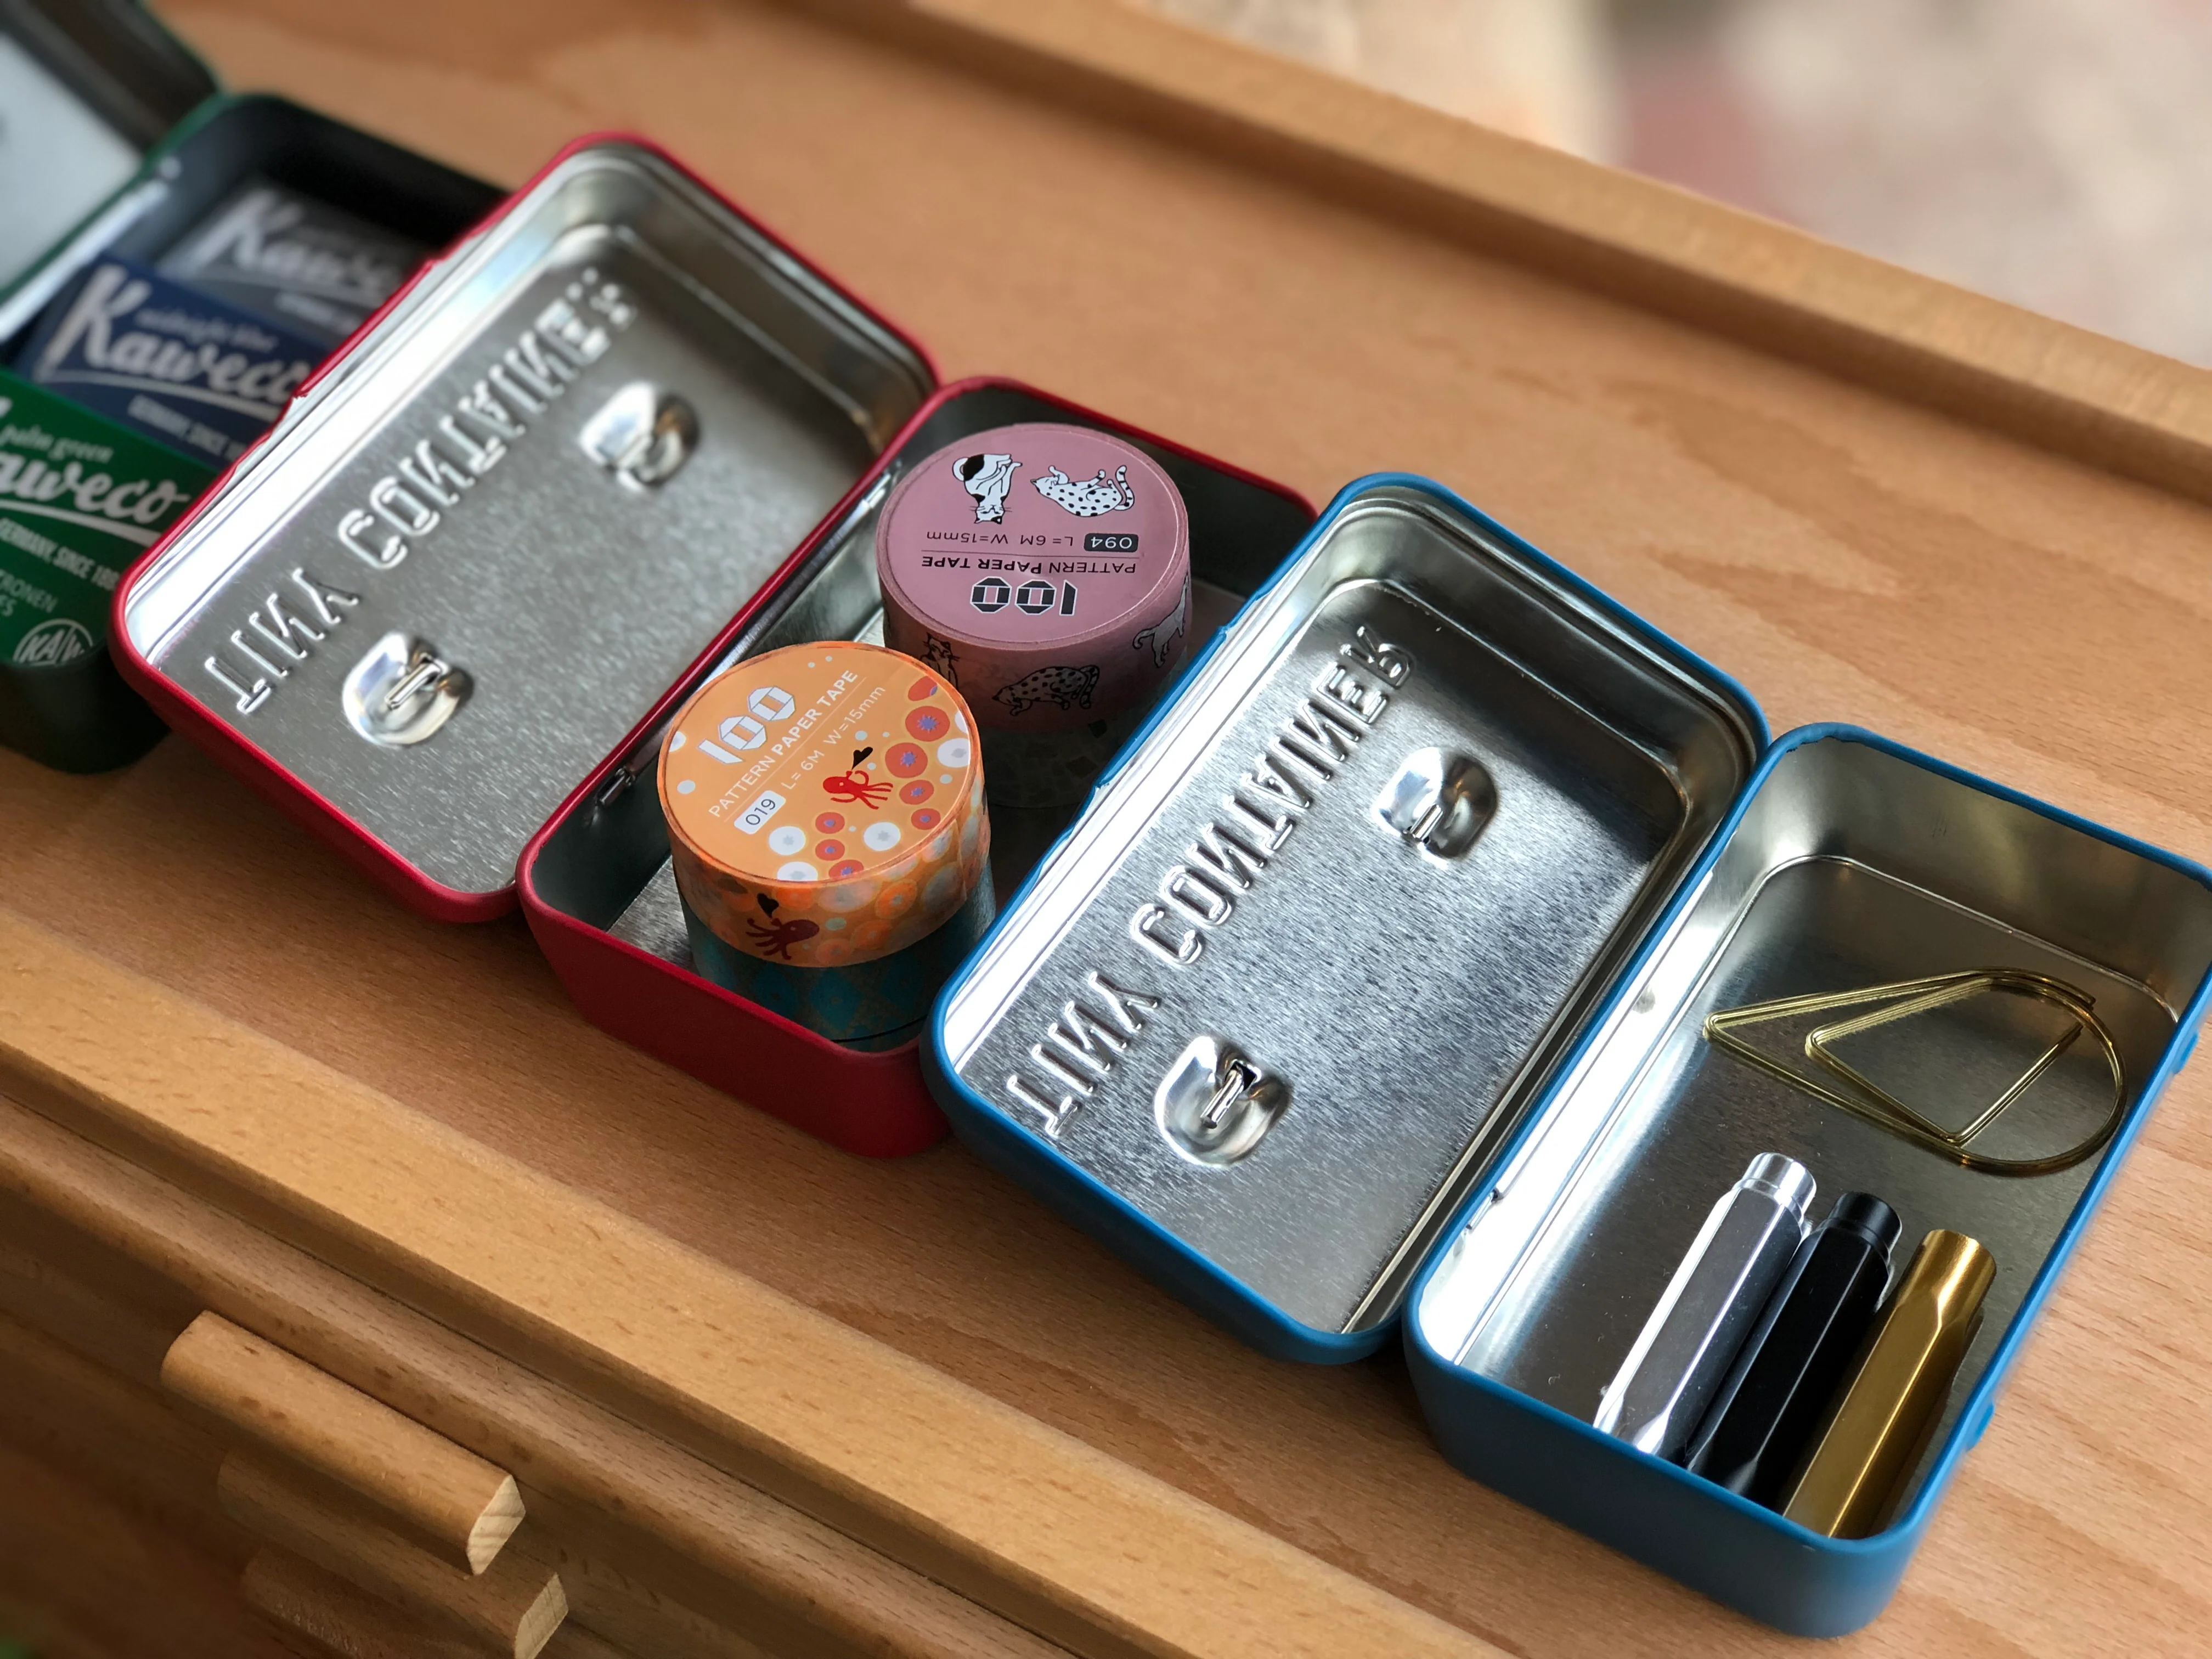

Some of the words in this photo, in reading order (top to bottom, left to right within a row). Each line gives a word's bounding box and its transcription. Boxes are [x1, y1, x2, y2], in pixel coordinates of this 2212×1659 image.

[0, 396, 191, 524] aweco
[926, 531, 1008, 544] W=15mm
[1090, 536, 1133, 549] 094
[922, 556, 970, 568] TAPE
[978, 558, 1042, 574] PAPER
[1049, 562, 1136, 574] PATTERN
[970, 576, 1077, 616] 100
[697, 685, 795, 765] 100
[708, 755, 776, 817] PATTERN
[771, 708, 823, 756] PAPER
[816, 670, 859, 707] TAPE
[745, 798, 776, 826] 019
[823, 686, 887, 746] W=15mm
